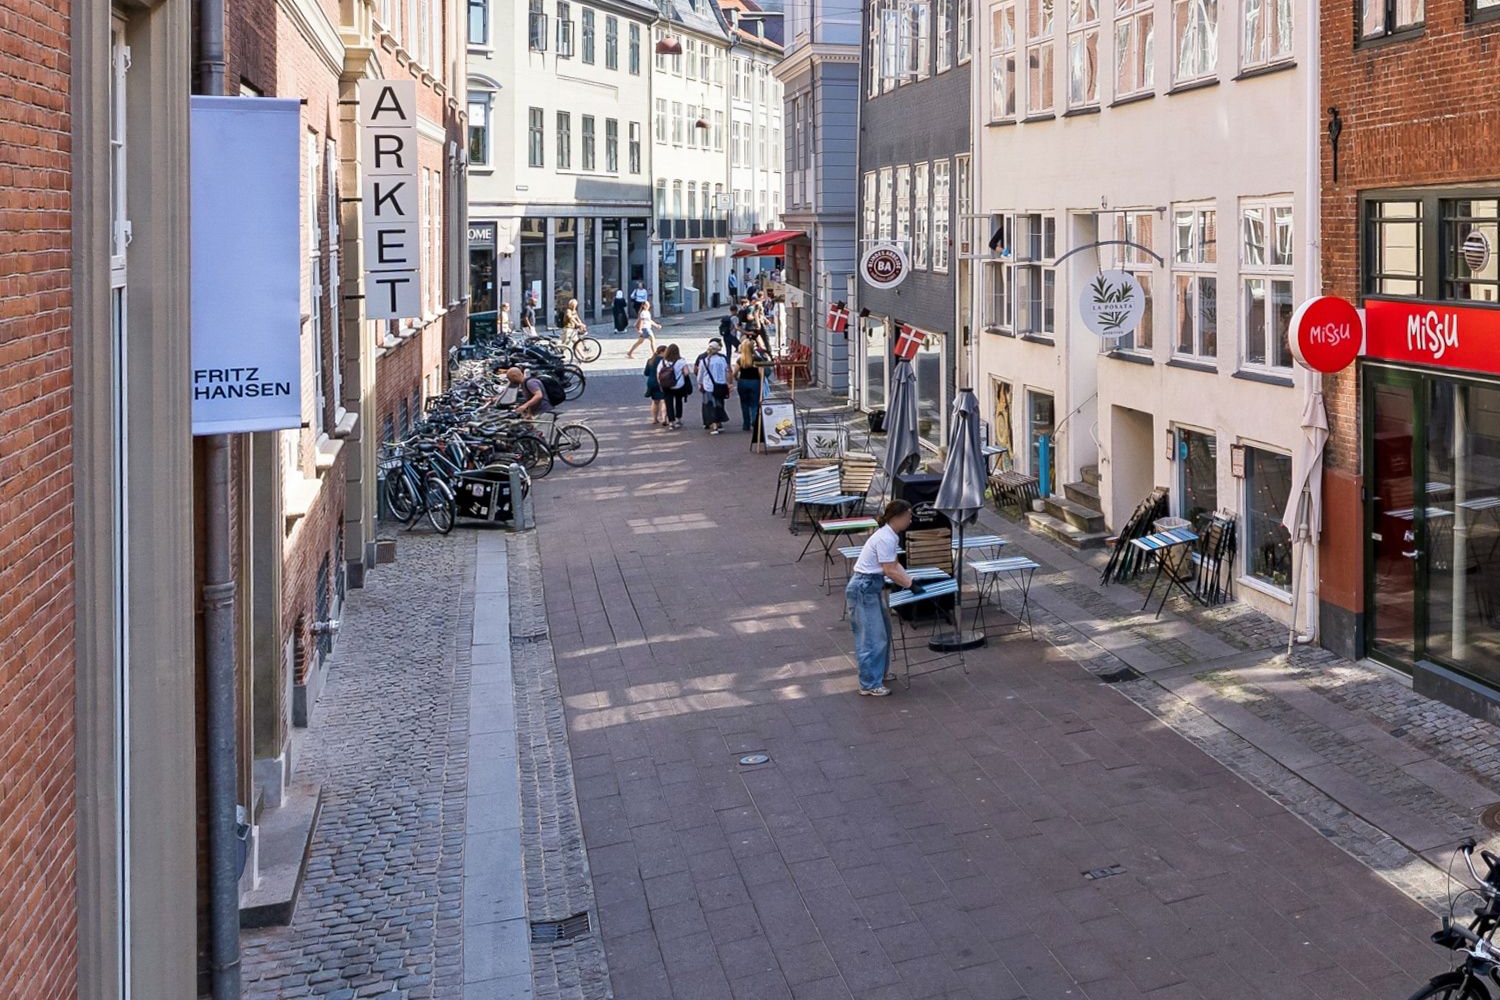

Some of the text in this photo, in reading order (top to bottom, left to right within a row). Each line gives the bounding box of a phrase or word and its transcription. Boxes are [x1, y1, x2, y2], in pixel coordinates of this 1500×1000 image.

[370, 86, 410, 313] ARKET
[877, 261, 892, 271] BA
[194, 367, 260, 384] FRITZ
[194, 382, 290, 400] HANSEN
